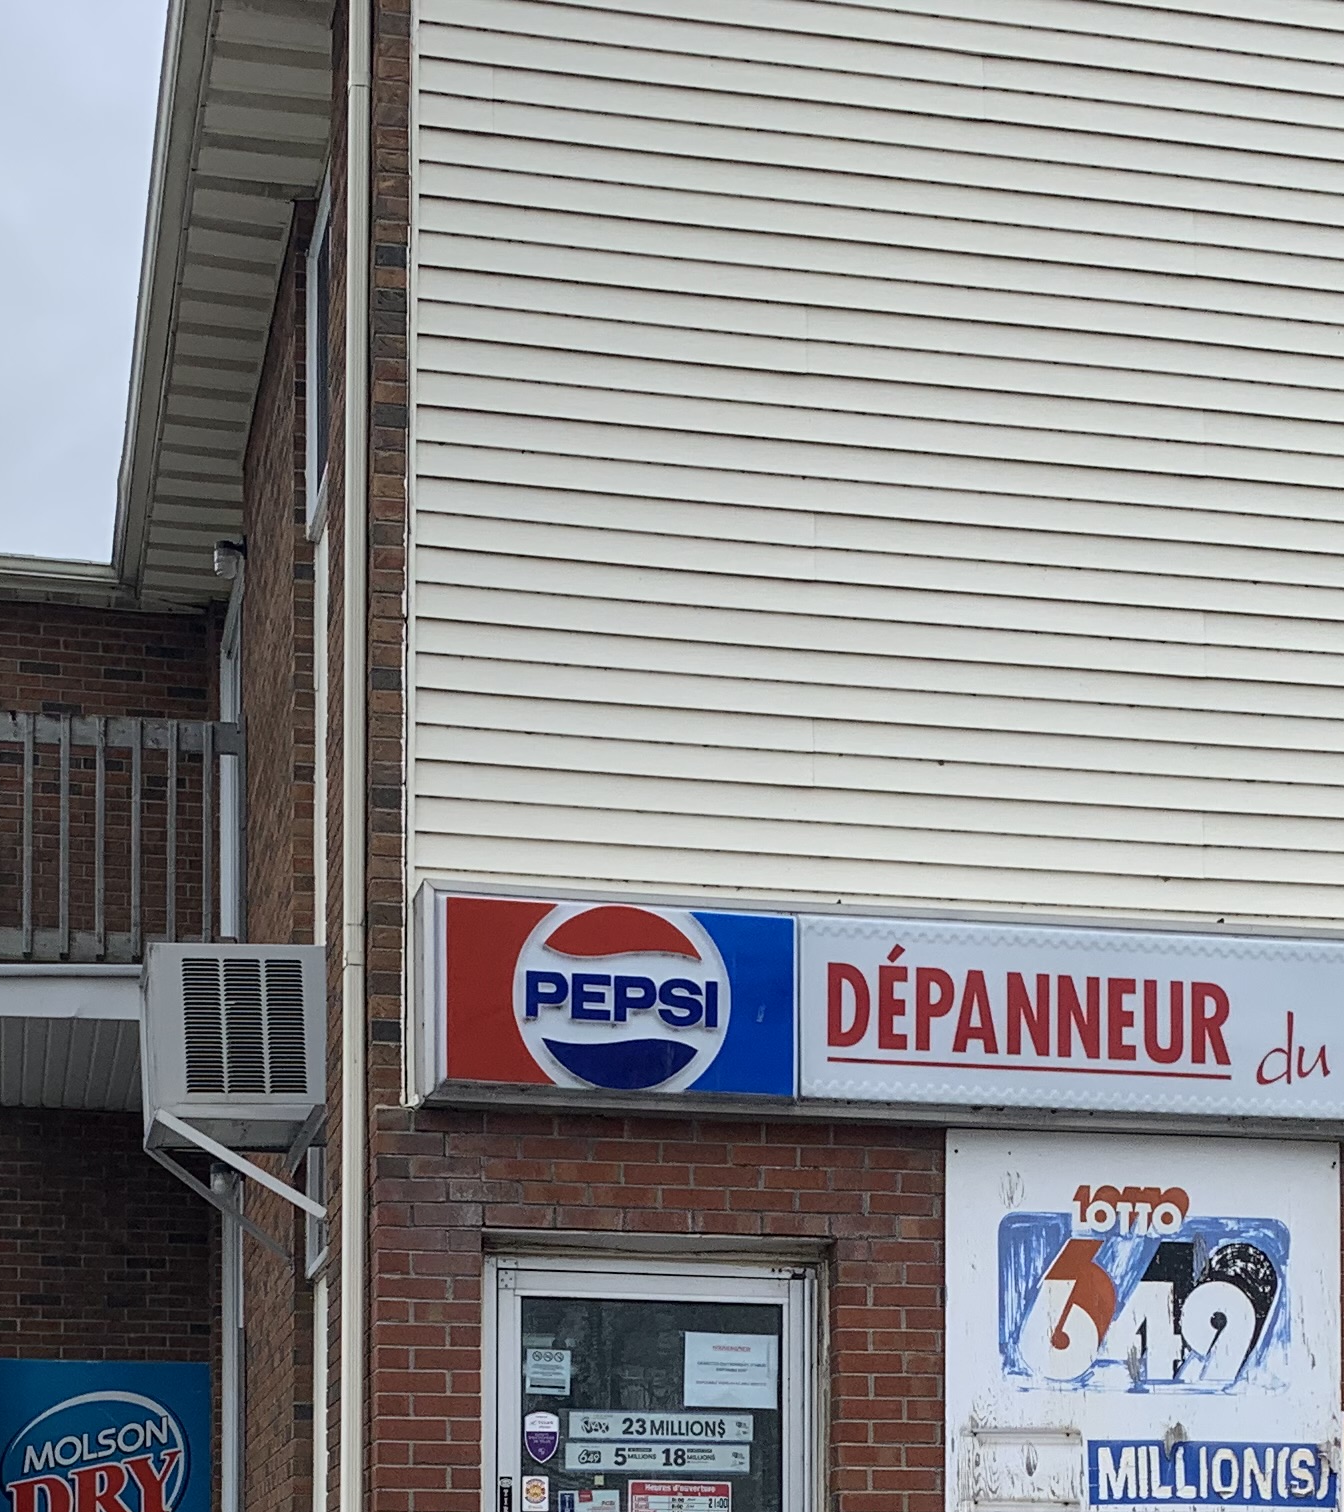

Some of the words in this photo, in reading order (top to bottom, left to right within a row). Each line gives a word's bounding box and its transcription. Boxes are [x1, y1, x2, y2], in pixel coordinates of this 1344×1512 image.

[524, 970, 720, 1030] PEPSI
[827, 943, 1232, 1067] DÉPANNEUR
[1255, 1010, 1331, 1087] du
[1072, 1190, 1187, 1235] LOTTO
[1018, 1250, 1270, 1384] 649
[23, 1416, 169, 1473] MOLSON
[622, 1418, 647, 1436] 23
[614, 1448, 627, 1466] 5
[662, 1448, 686, 1466] 18
